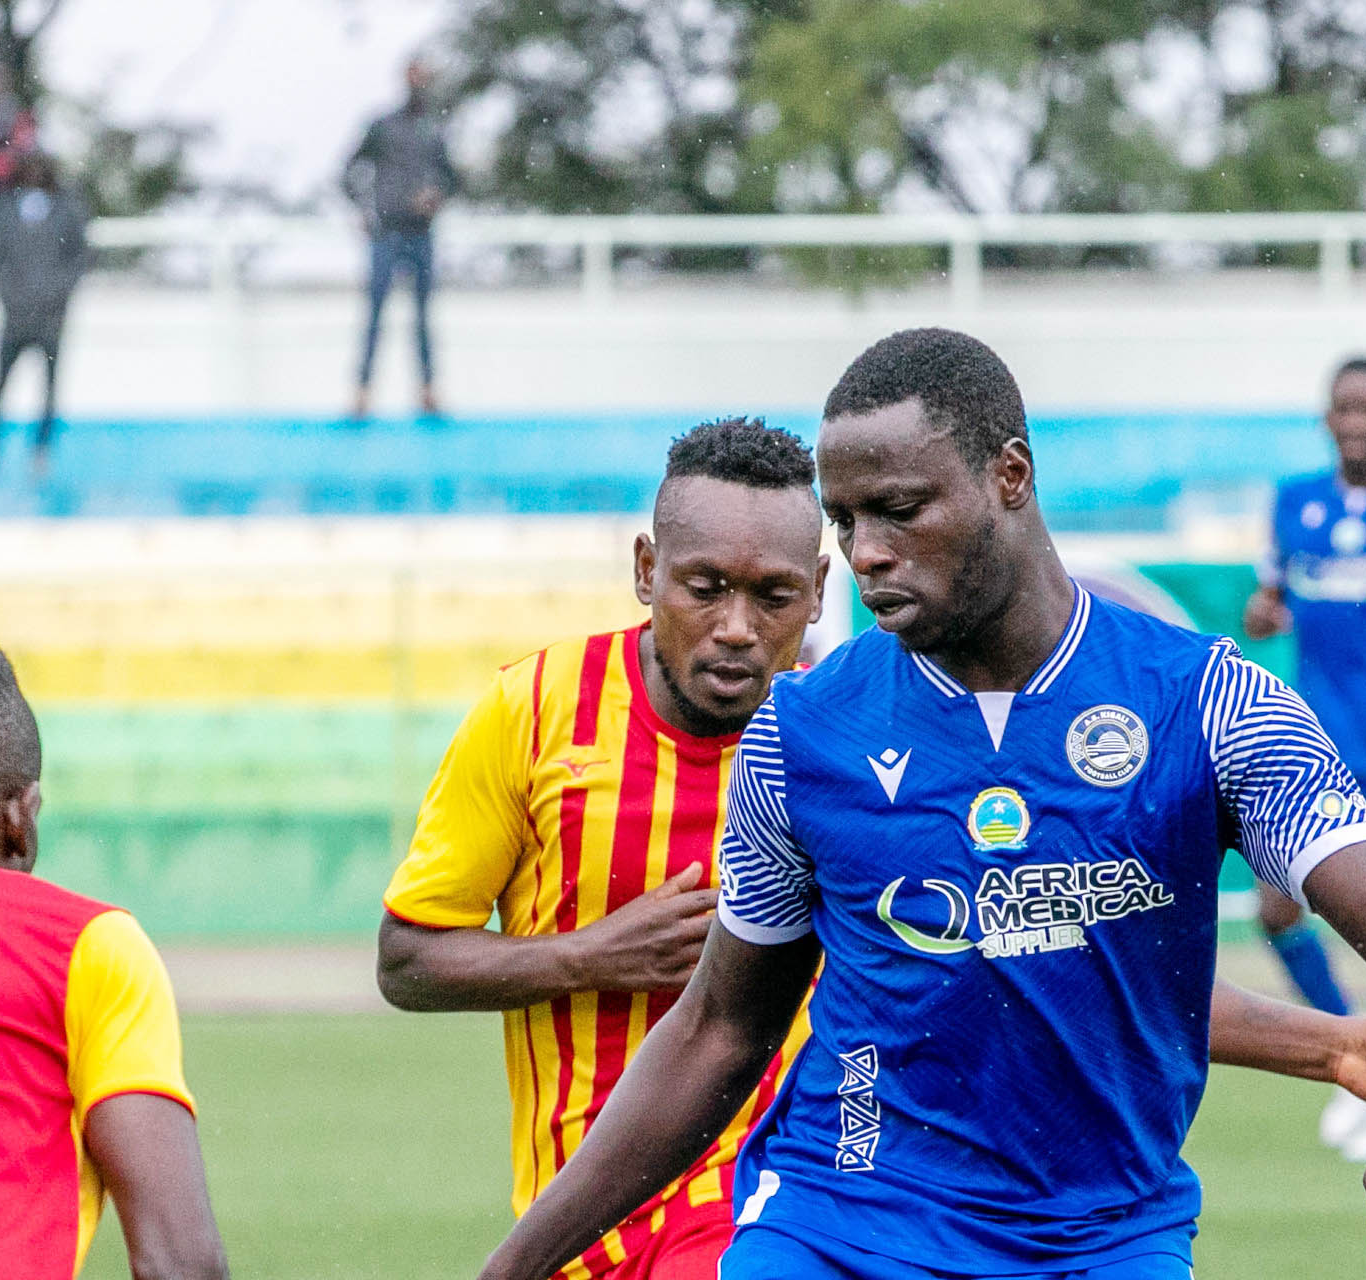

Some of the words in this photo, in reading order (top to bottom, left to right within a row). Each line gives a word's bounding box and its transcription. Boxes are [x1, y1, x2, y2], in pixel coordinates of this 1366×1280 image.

[975, 859, 1151, 902] AFRICA
[978, 884, 1174, 934] MEDICAL
[983, 925, 1087, 958] SUPPLIER
